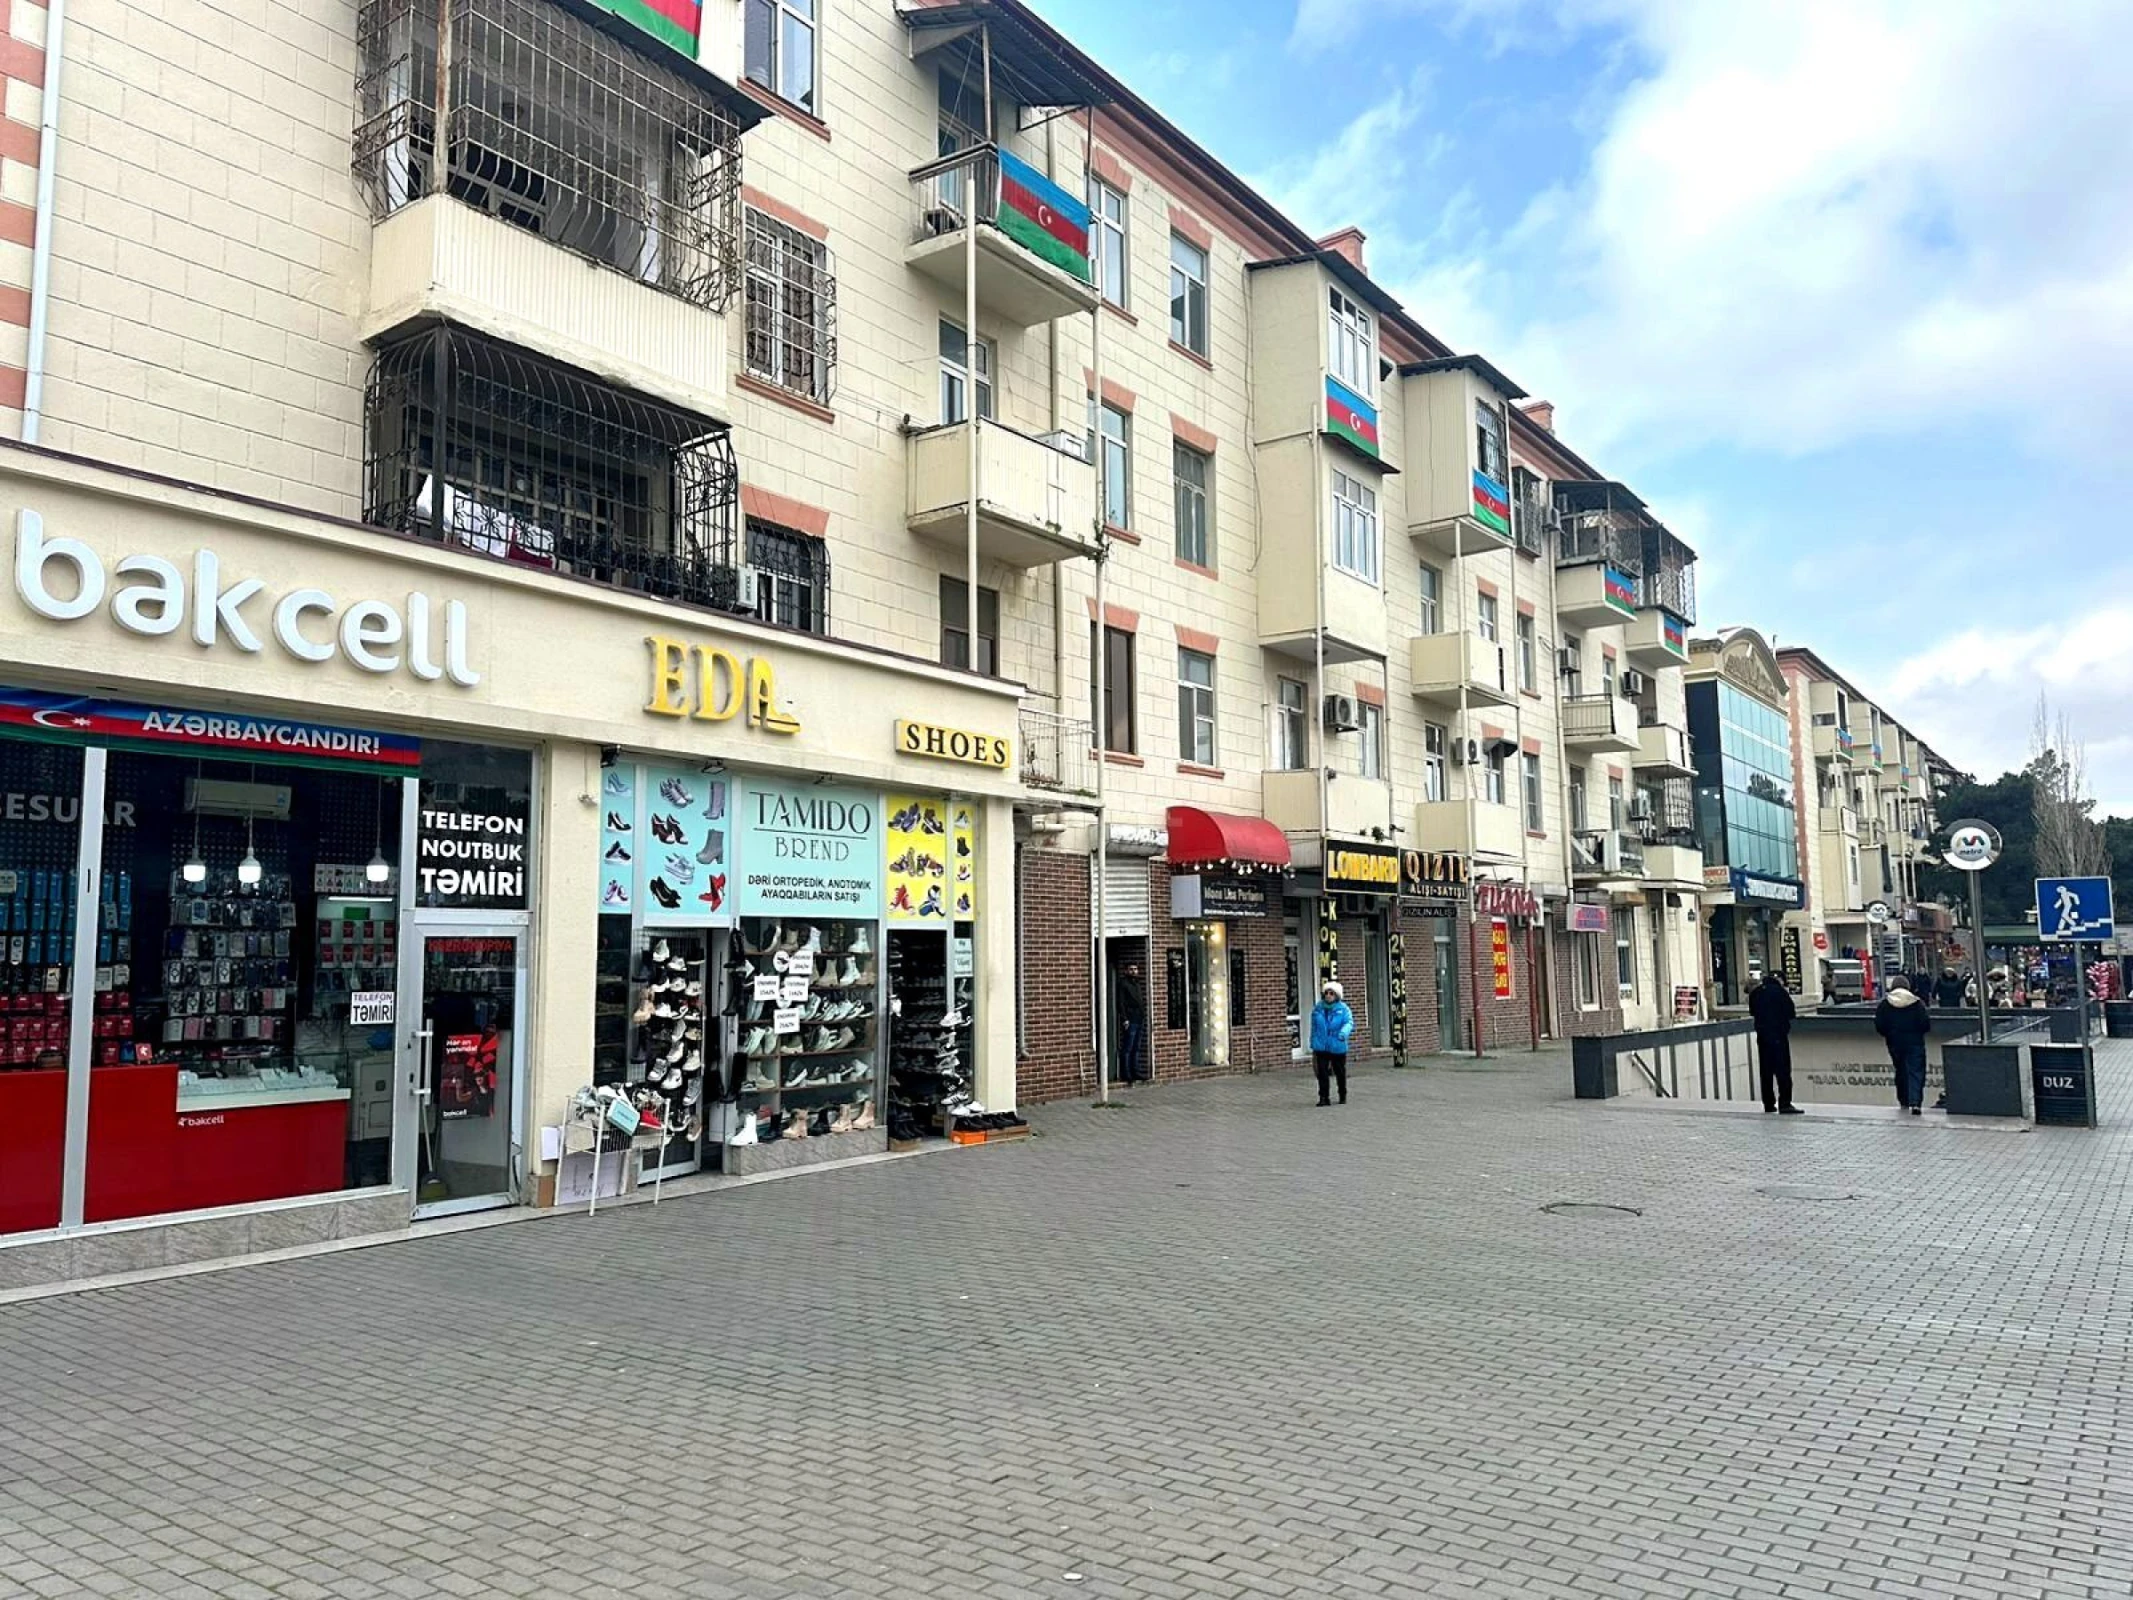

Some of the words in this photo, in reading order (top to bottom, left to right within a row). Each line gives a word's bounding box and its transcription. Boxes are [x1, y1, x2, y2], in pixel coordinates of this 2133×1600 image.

[15, 508, 481, 687] bakcell
[643, 635, 800, 735] EDA
[142, 711, 380, 755] AZƏRBAYCANDIR!
[906, 723, 1006, 765] SHOES
[0, 792, 137, 828] ESUR
[422, 810, 523, 835] TELEFON
[748, 791, 871, 834] TAMIDO
[422, 838, 523, 861] NOUTBUK
[775, 836, 849, 861] BREND
[420, 864, 523, 896] TƏMİRİ
[748, 874, 771, 885] DƏRİ
[827, 878, 871, 890] ANOTOMİK
[1327, 850, 1398, 883] LOMBARD
[1404, 851, 1468, 884] QIZIL
[761, 889, 832, 901] AYAQQABILARIN
[834, 892, 860, 903] SATIŞI
[353, 1000, 393, 1022] TƏMİRİ
[2043, 1077, 2074, 1088] DUZ
[188, 1115, 224, 1126] bakcell
